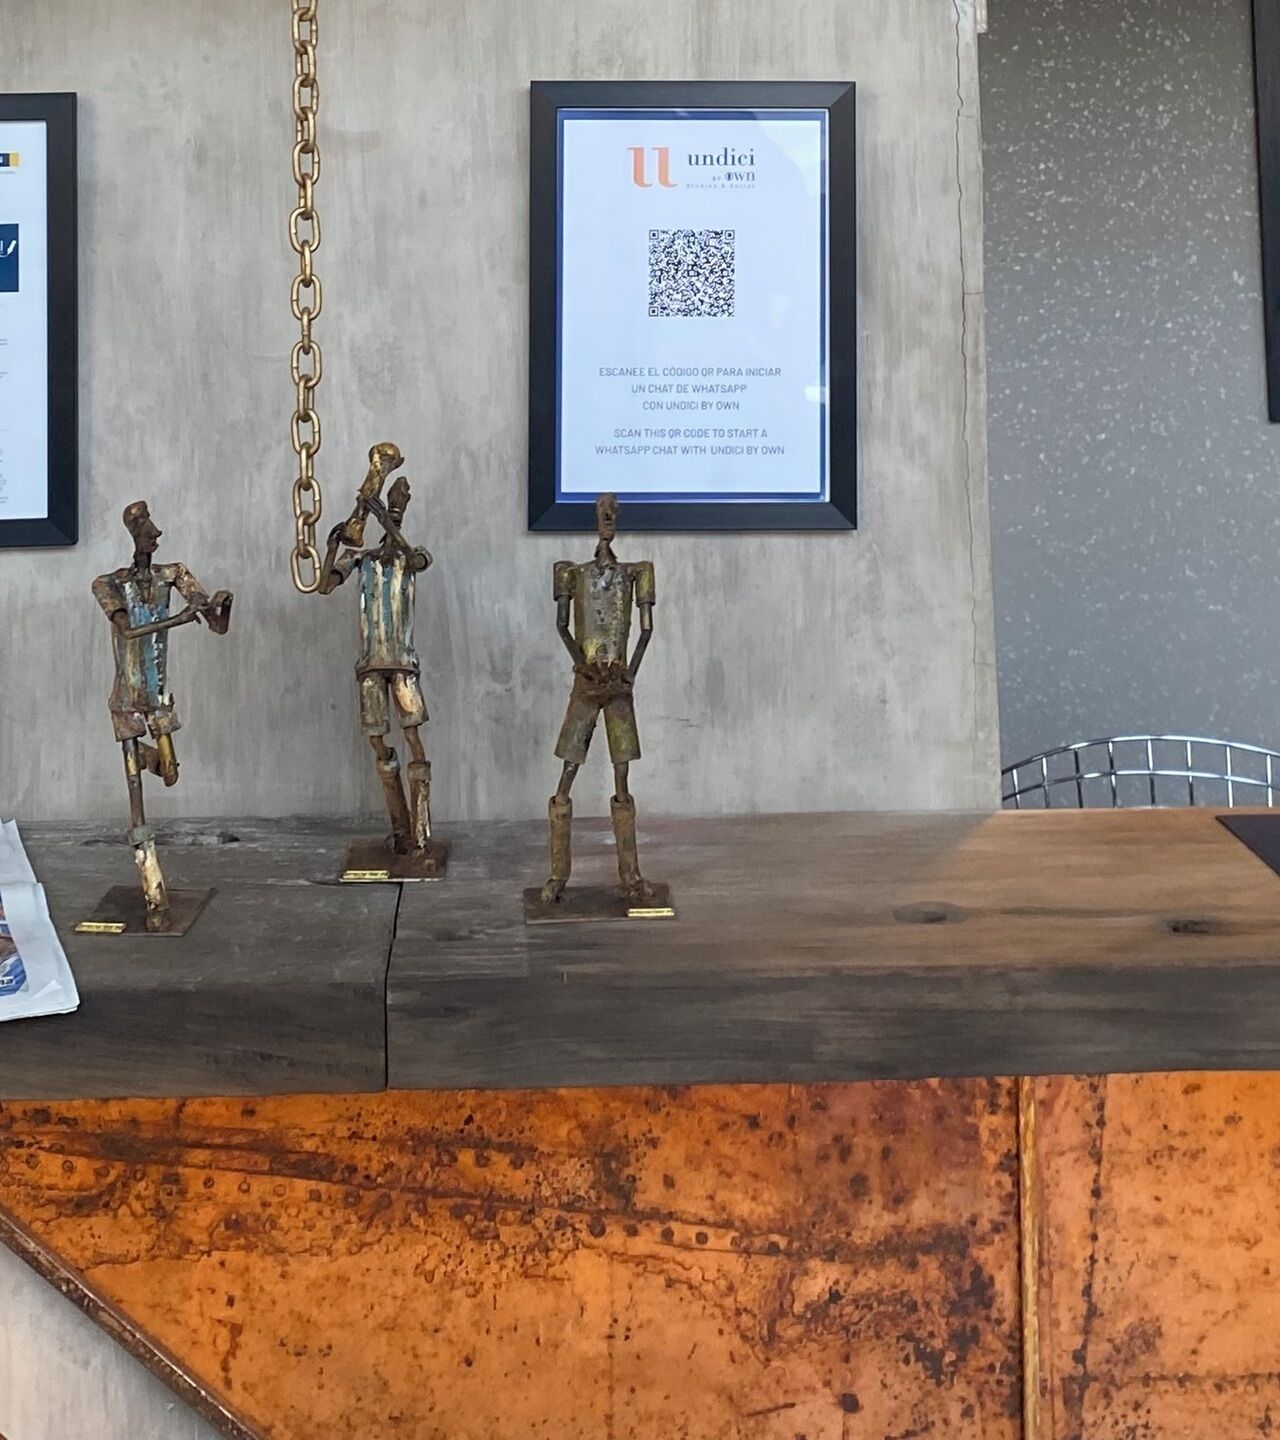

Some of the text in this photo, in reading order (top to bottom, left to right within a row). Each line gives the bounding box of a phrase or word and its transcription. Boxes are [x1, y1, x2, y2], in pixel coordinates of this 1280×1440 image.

[687, 147, 755, 167] undici
[599, 367, 646, 377] ESCANEE
[648, 367, 660, 377] EL
[701, 367, 714, 378] QR
[716, 367, 743, 377] PARA
[745, 367, 782, 377] INICIAR
[631, 384, 748, 394] UN CHAT DE WHATSAPP
[642, 400, 740, 411] CON UNDICI BY OWN
[614, 428, 768, 439] SCAN THIS QR CODE TO START A
[595, 445, 785, 455] WHATSAPP CHAT WITH UNDICI BY OWN
